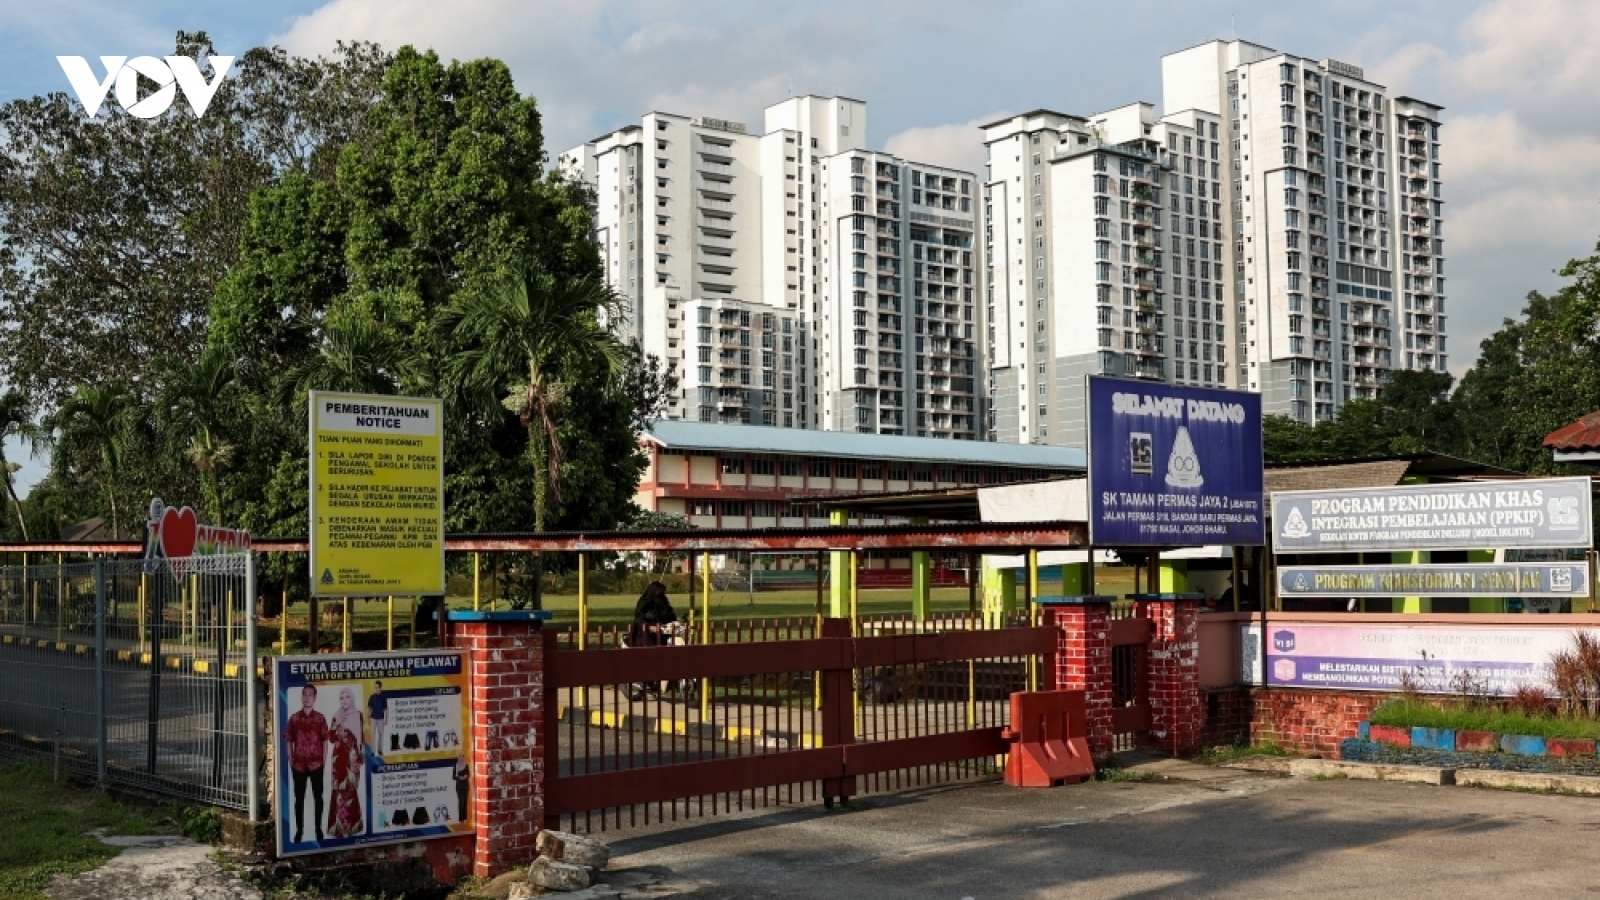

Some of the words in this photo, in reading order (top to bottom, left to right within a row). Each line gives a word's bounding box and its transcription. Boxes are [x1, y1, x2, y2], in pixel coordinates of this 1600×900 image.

[326, 402, 430, 419] PEMBERITAHUAN
[356, 416, 401, 429] NOTICE
[342, 437, 362, 445] PUAN
[363, 437, 383, 445] YANG
[385, 438, 423, 447] DIHORMATI
[328, 451, 344, 459] SILA
[349, 452, 374, 460] LAPOR
[378, 453, 393, 461] DIRI
[397, 454, 404, 462] DI
[408, 455, 438, 463] PONDOK
[328, 460, 371, 468] PENGAWAL
[374, 461, 410, 470] SEKOLAH
[413, 462, 438, 471] UNTUK
[328, 484, 344, 492] SILA
[347, 485, 369, 493] HADIR
[371, 485, 380, 493] KE
[382, 486, 412, 494] PEJABAT
[414, 486, 438, 494] UNTUK
[328, 492, 359, 500] SEGALA
[363, 493, 393, 501] URUSAN
[398, 494, 438, 502] BERKAITAN
[1103, 492, 1118, 505] SK
[1120, 493, 1155, 506] TAMAN
[1158, 494, 1198, 508] PERMAS
[1199, 496, 1222, 509] JAYA
[1222, 497, 1228, 508] 2
[1312, 496, 1385, 514] PROGRAM
[1389, 492, 1491, 512] PENDIDIKAN
[1495, 489, 1543, 508] KHAS
[328, 500, 359, 508] DENGAN
[361, 501, 396, 509] SEKOLAH
[329, 517, 381, 525] KENDERAAN
[385, 517, 409, 525] AWAM
[414, 518, 438, 526] TIDAK
[1103, 511, 1125, 521] JALAN
[1127, 511, 1155, 521] PERMAS
[1171, 512, 1198, 522] BANDAR
[1199, 513, 1216, 523] BARU
[1217, 513, 1242, 523] PERMAS
[1312, 514, 1378, 530] INTEGRASI
[1381, 511, 1487, 528] PEMBELAJARAN
[1490, 509, 1544, 527] (PPKIP)
[329, 525, 377, 533] DIBENARKAN
[380, 525, 405, 533] MASUK
[408, 525, 438, 533] KECUALI
[1182, 525, 1204, 534] JOHOR
[1369, 531, 1399, 541] PROGRAM
[329, 541, 348, 549] ATAS
[352, 541, 396, 549] KEBENARAN
[397, 541, 417, 549] OLEH
[1315, 573, 1375, 590] PROGRAM
[1379, 572, 1475, 590] TRANSFORMASI
[290, 662, 327, 675] ETIKA
[330, 658, 404, 673] BERPAKAIAN
[407, 656, 459, 668] PELAWAT
[1320, 663, 1380, 674] MELESTARIKAN
[304, 672, 352, 681] VISITOR'S
[354, 670, 384, 679] DRESS
[387, 668, 412, 677] CODE
[1302, 673, 1371, 684] MEMBANGUNKAN
[1372, 676, 1407, 686] POTEN
